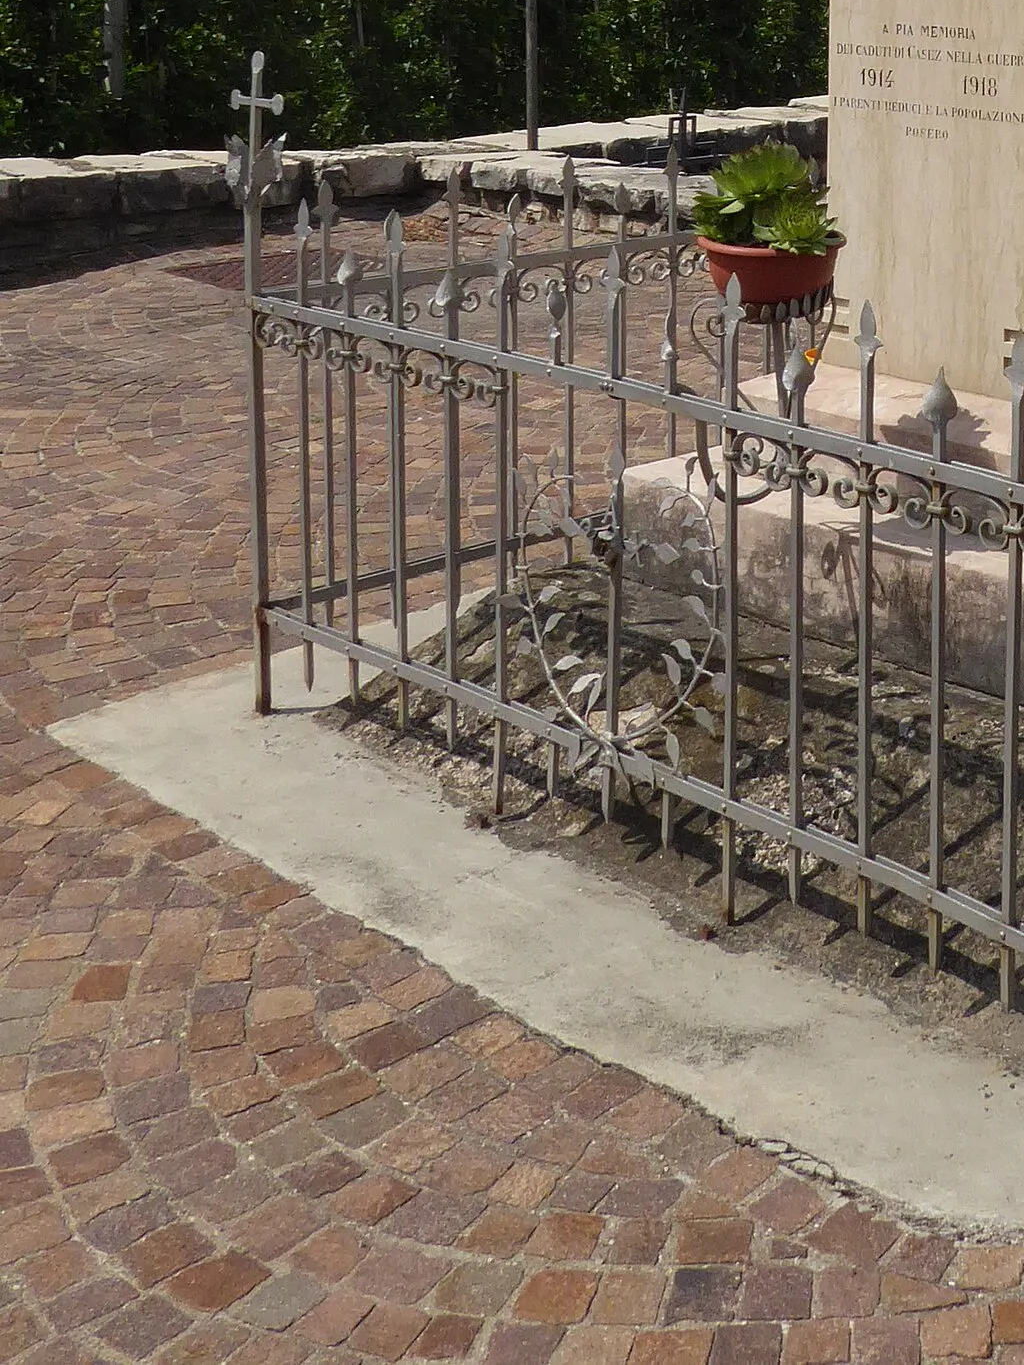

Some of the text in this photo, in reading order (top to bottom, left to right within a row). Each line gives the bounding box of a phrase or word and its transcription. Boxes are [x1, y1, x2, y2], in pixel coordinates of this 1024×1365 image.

[882, 24, 976, 40] A PIA MEMORIA
[836, 43, 853, 54] DEI
[856, 44, 892, 57] CADUTI
[894, 47, 904, 58] DI
[946, 51, 982, 65] NELLA
[859, 68, 997, 97] 1914 1918
[840, 97, 881, 111] PARENTI
[884, 101, 921, 114] REDUCI
[935, 105, 948, 116] LA
[905, 126, 949, 140] POSERO
